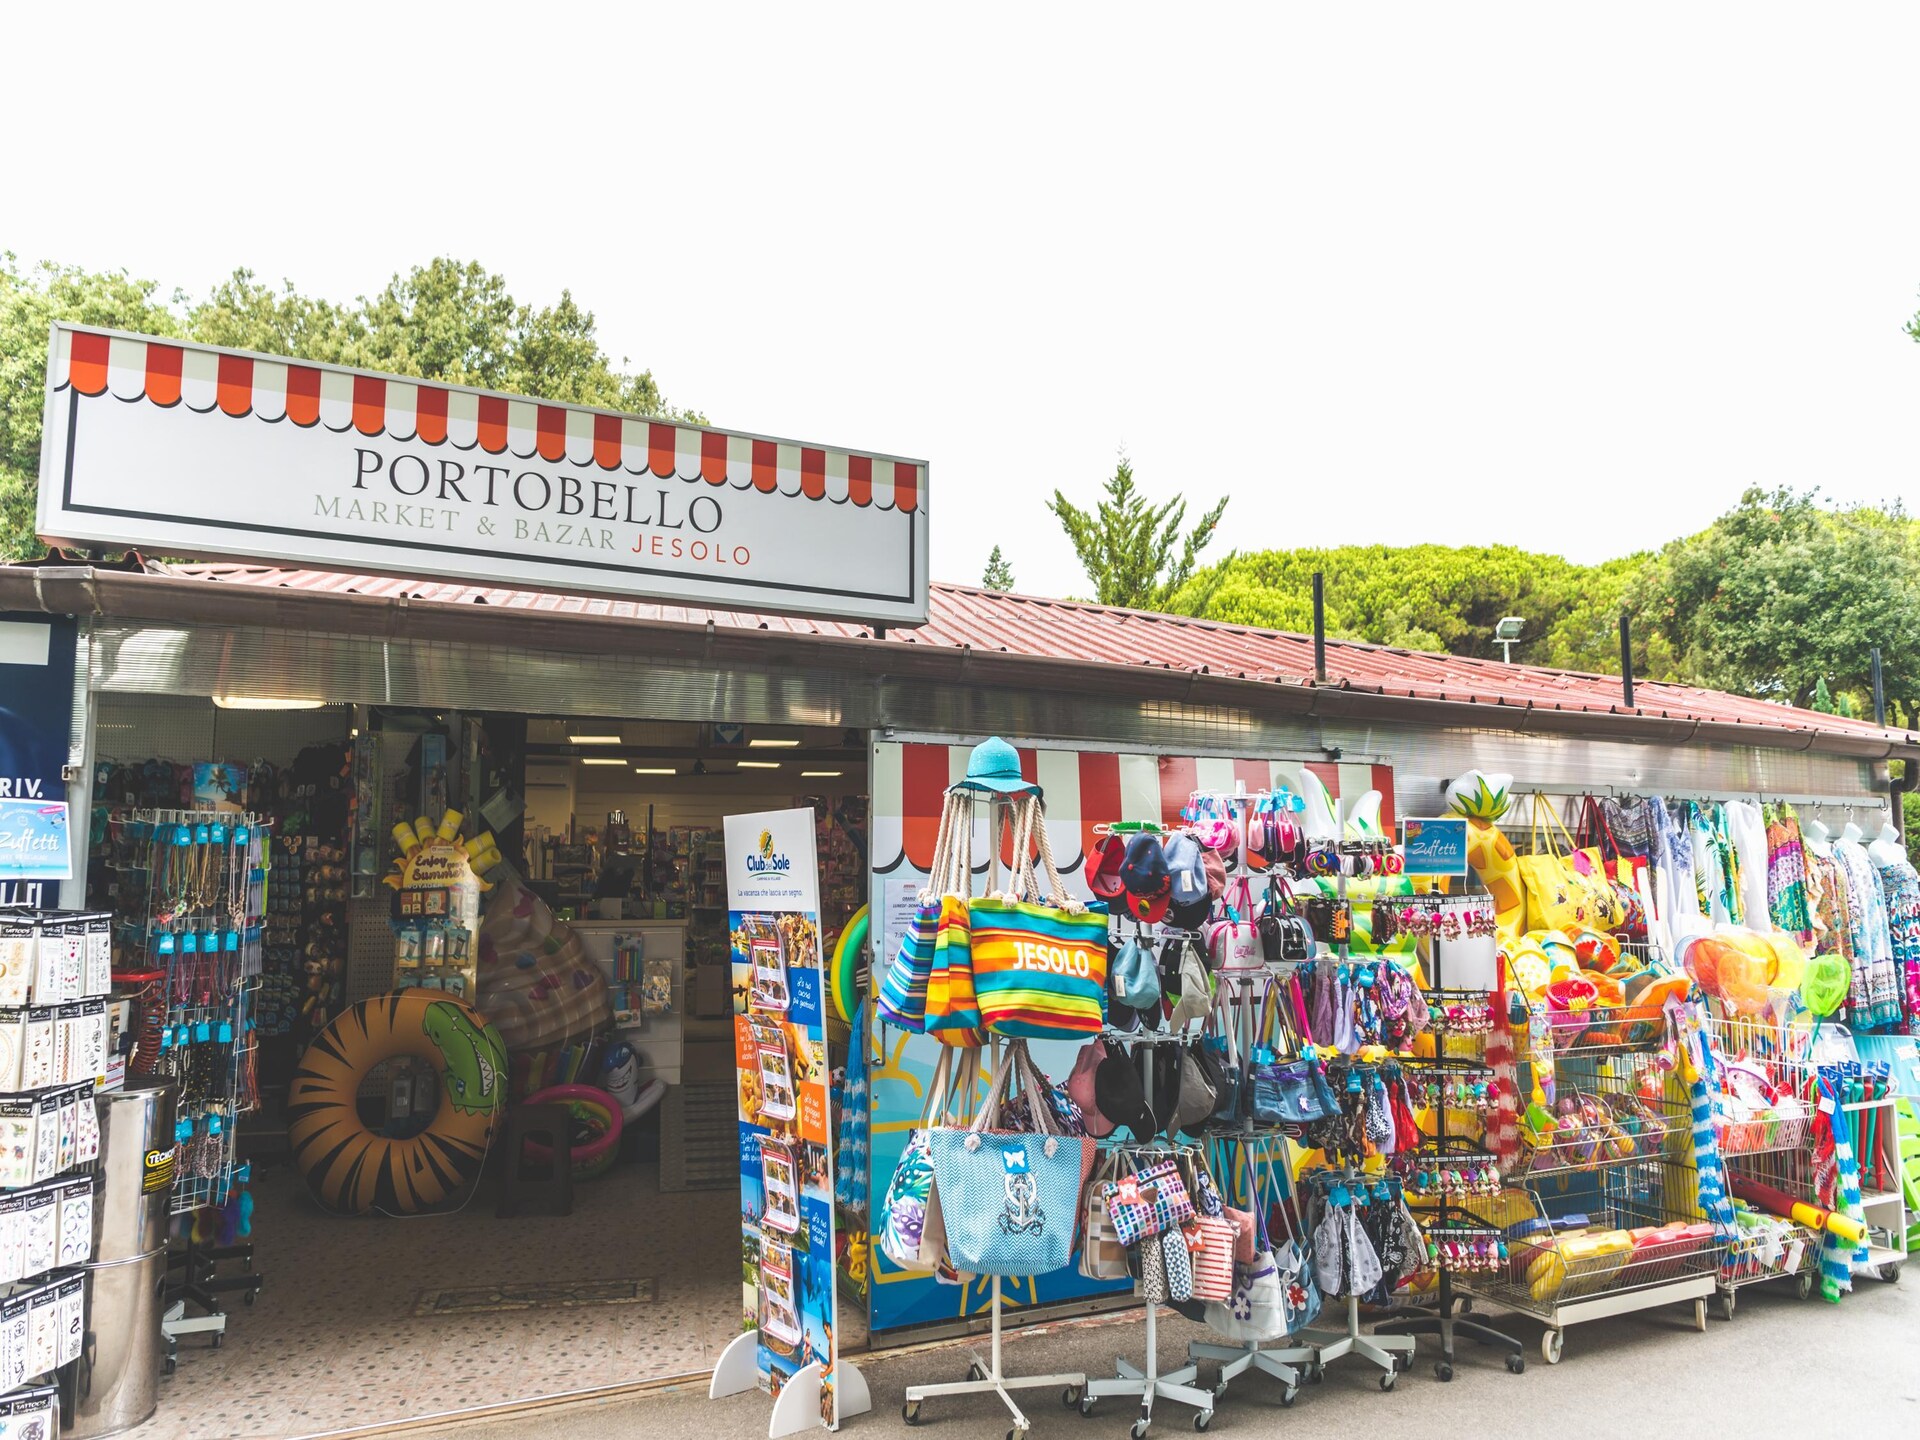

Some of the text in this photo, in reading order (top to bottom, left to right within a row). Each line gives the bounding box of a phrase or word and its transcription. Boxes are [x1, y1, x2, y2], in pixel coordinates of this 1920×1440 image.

[352, 448, 723, 533] PORTOBELLO
[313, 494, 751, 566] MARKET & BAZAR JESOLO
[1412, 839, 1458, 857] Zuffetti
[415, 855, 448, 868] Enjoy
[747, 854, 765, 871] Club
[772, 853, 790, 870] Sole
[412, 868, 464, 881] Summer
[1012, 941, 1090, 978] JESOLO
